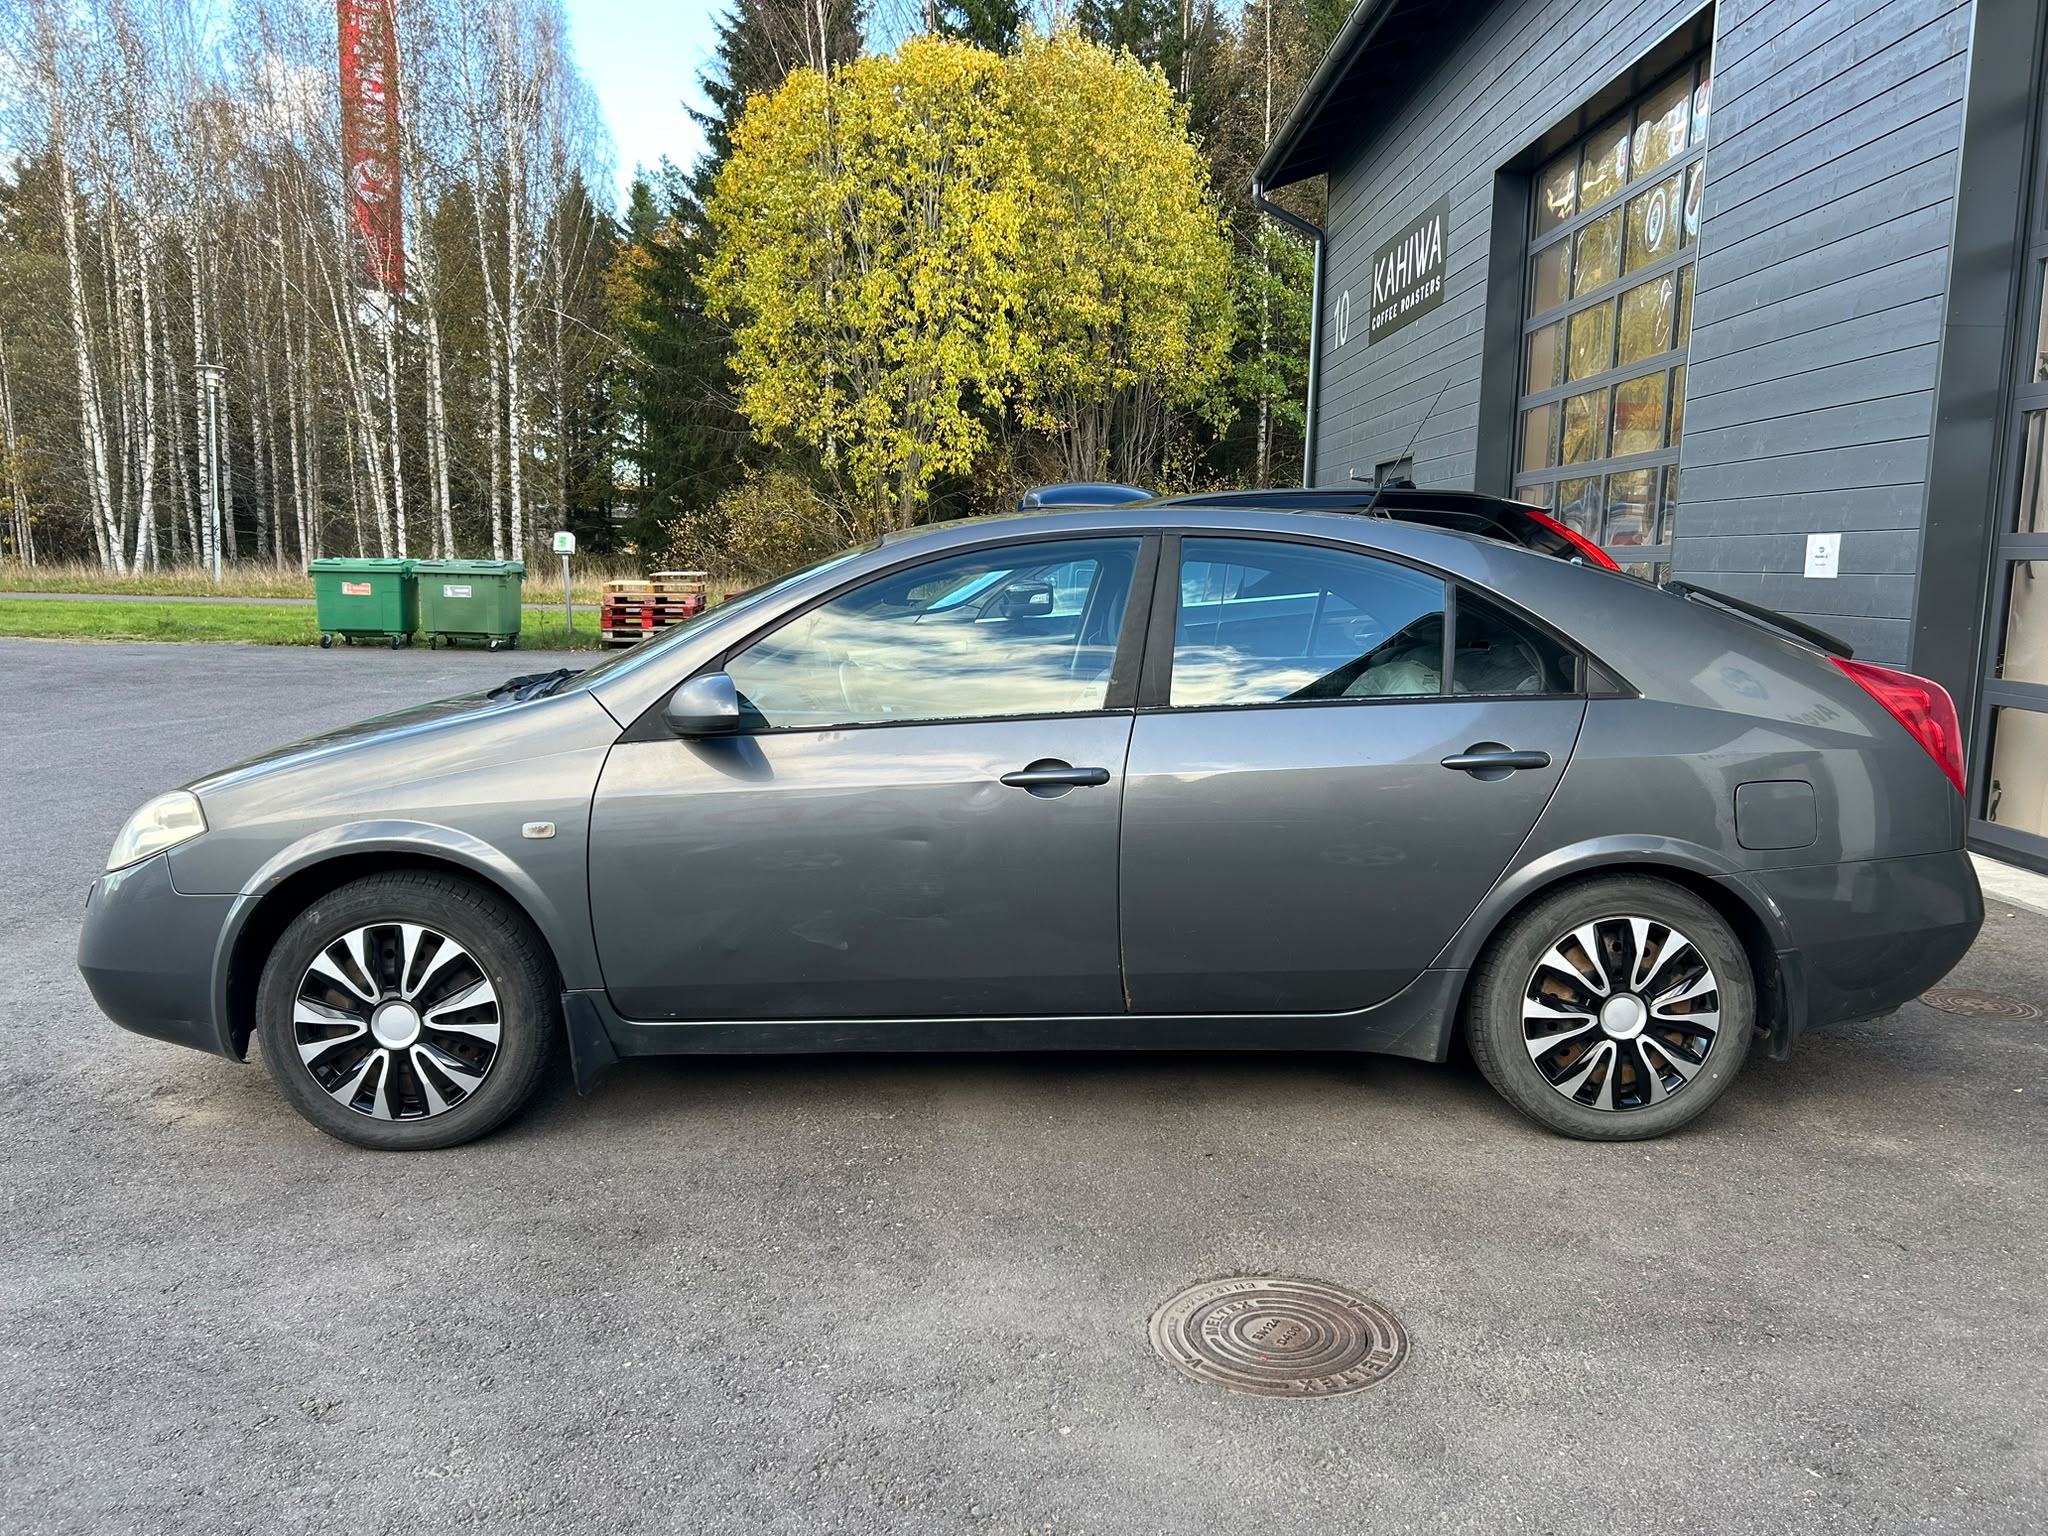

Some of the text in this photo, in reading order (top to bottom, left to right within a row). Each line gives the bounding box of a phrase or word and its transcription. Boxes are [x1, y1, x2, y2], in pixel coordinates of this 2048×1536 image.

[1372, 214, 1442, 308] KAHIWA
[1333, 289, 1350, 350] 10
[1371, 275, 1441, 331] COFFEE ROASTERS
[1204, 1300, 1255, 1336] MELTEX
[1251, 1318, 1281, 1341] EN124
[1276, 1326, 1302, 1346] D400
[1299, 1349, 1393, 1392] MELTEX
